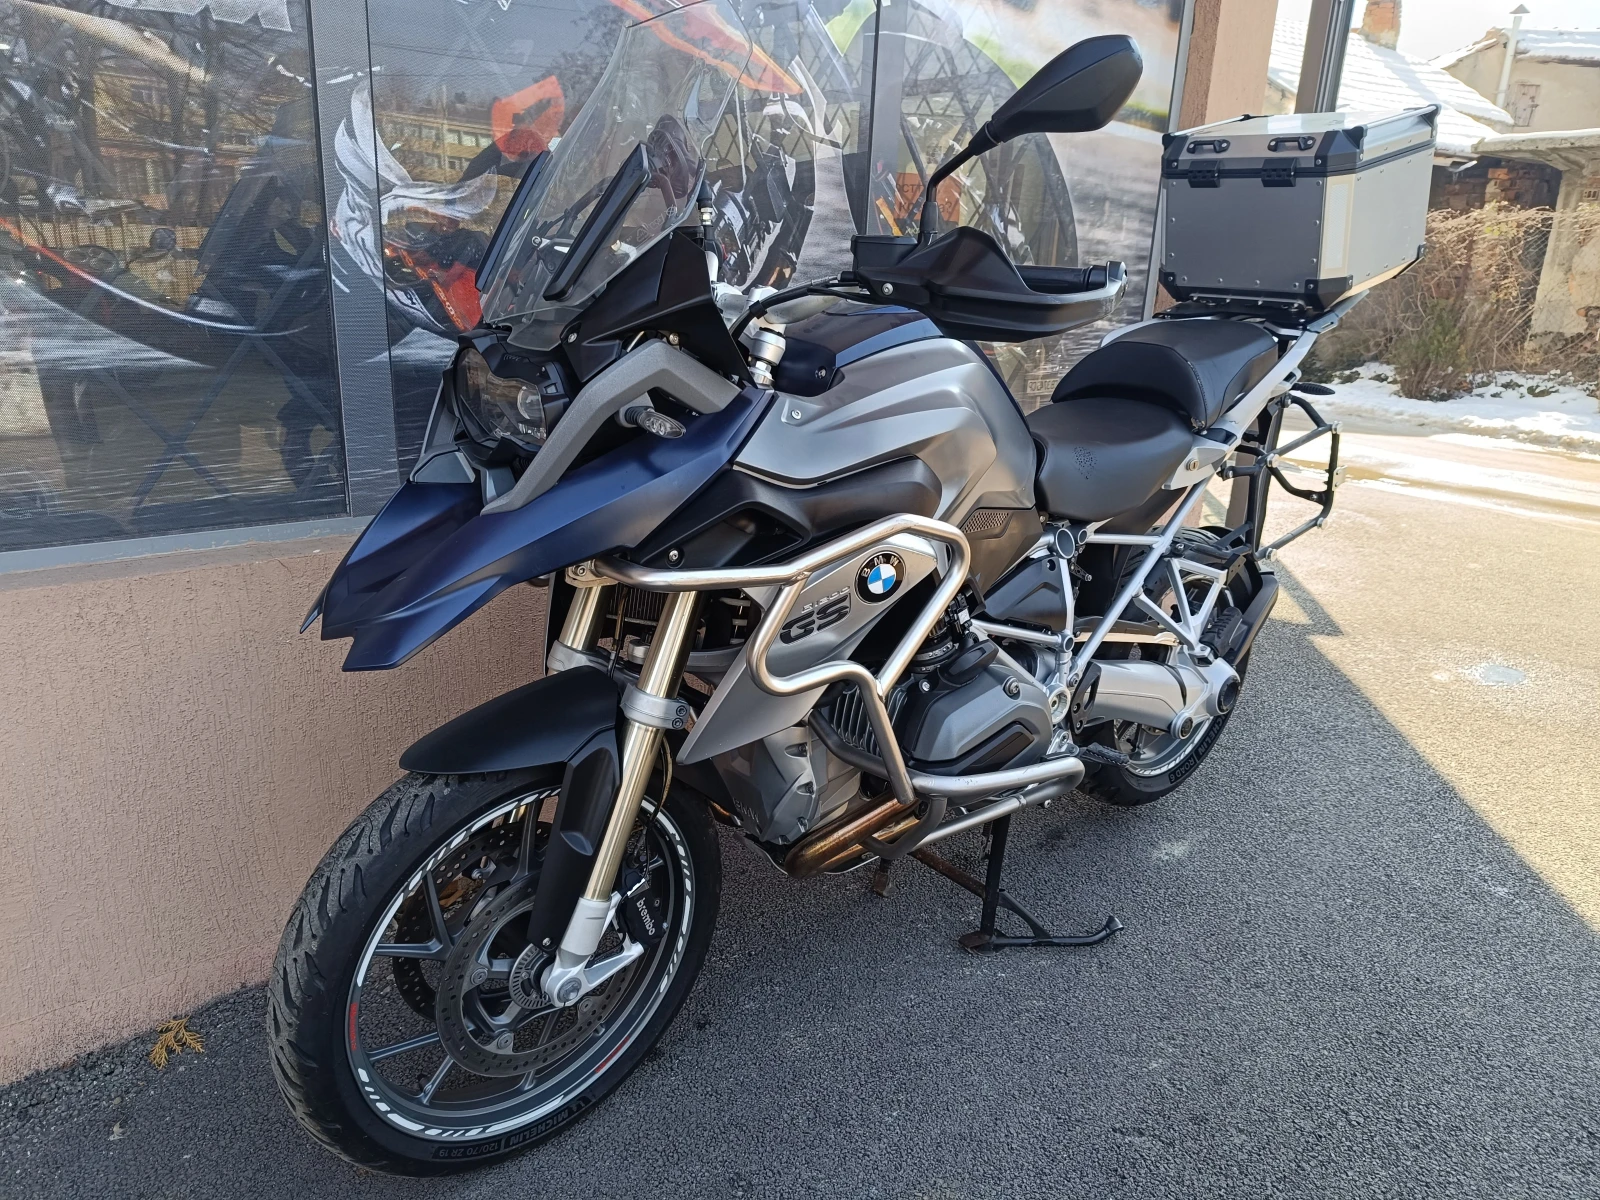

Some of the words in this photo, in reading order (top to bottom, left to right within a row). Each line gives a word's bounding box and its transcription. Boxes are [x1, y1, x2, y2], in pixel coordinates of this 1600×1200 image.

[860, 555, 899, 578] BMW
[779, 594, 852, 645] GS
[1197, 714, 1227, 756] ICHELIN
[1169, 774, 1176, 782] 6
[1175, 757, 1195, 778] ROAD
[636, 897, 656, 936] brembo
[509, 1110, 569, 1146] MICHELIN
[439, 1149, 449, 1157] 19
[450, 1148, 465, 1157] ZR
[466, 1142, 499, 1156] 120/70
